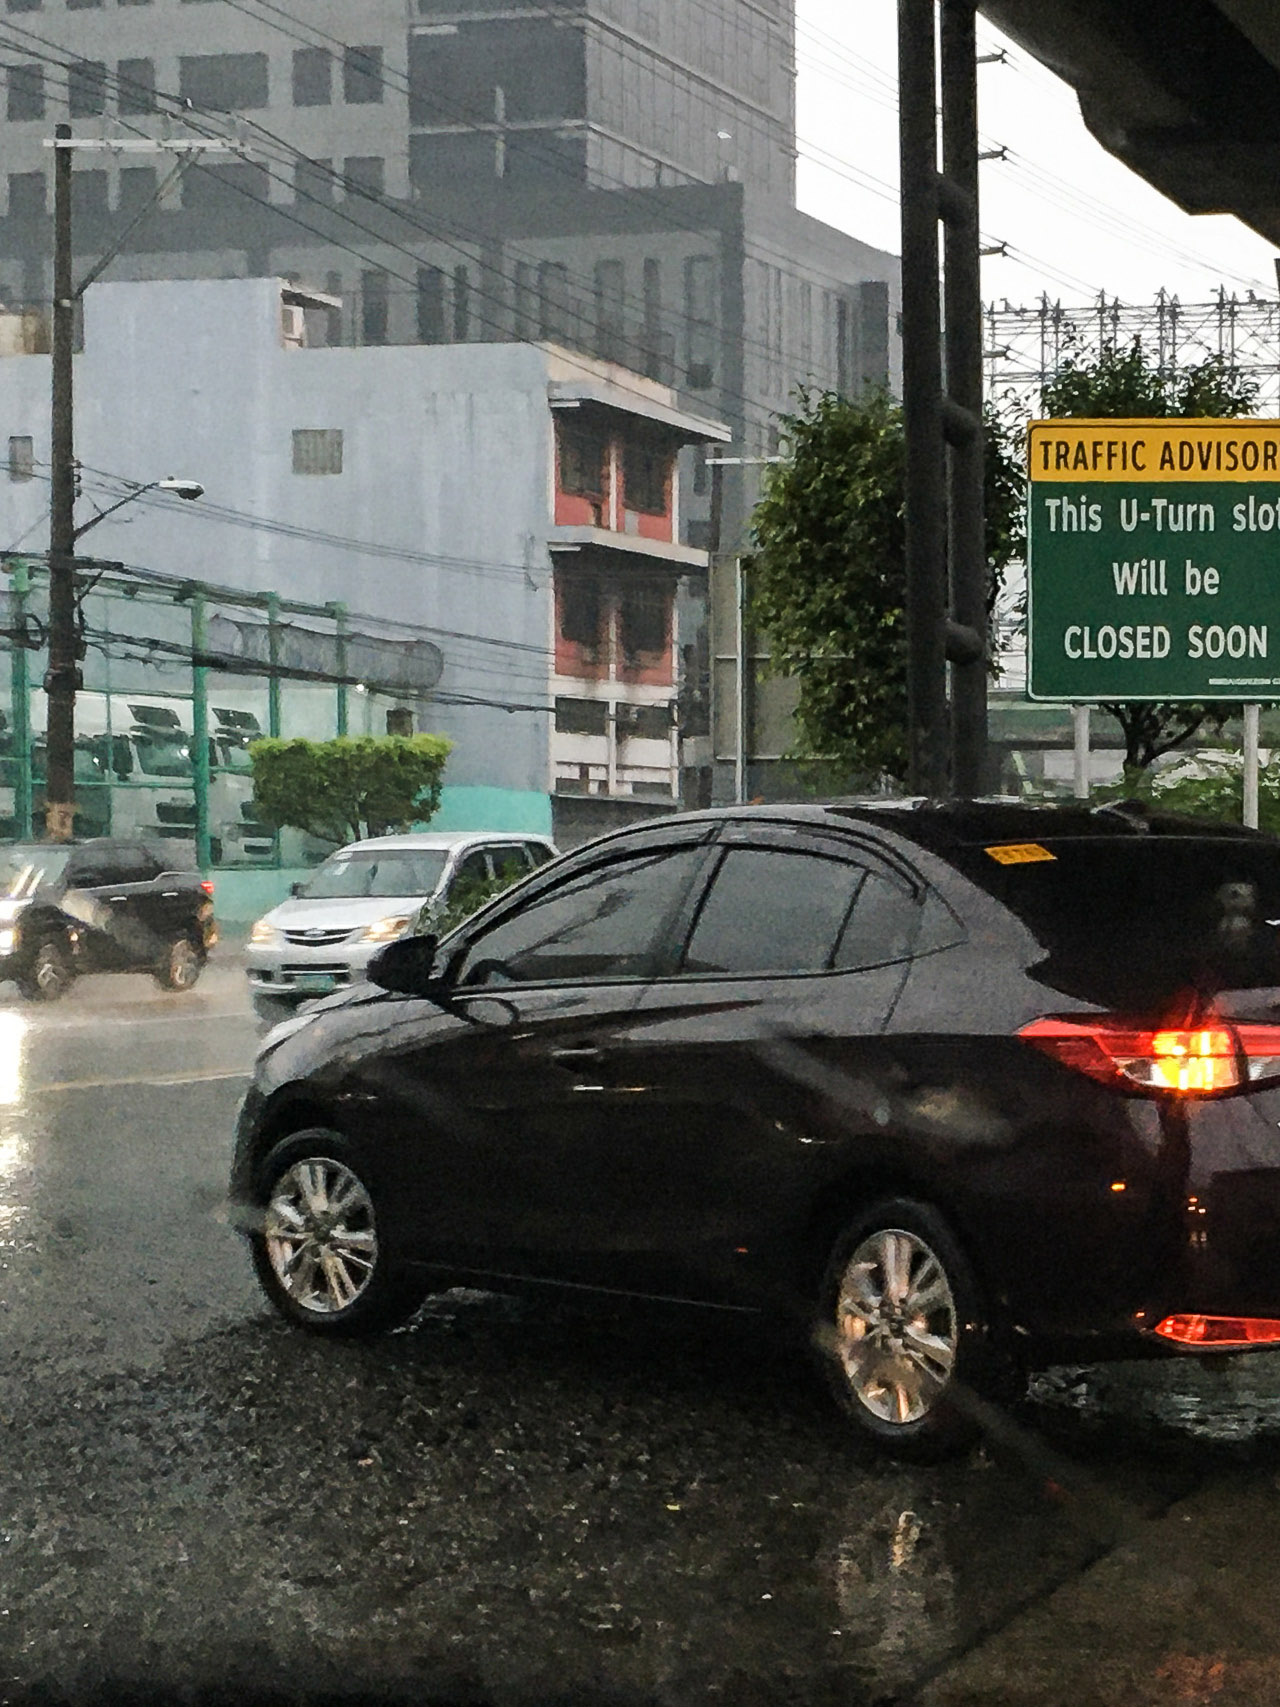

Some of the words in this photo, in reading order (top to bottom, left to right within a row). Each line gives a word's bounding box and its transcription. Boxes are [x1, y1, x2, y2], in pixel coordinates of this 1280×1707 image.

[1039, 440, 1147, 471] TRAFFIC
[1044, 495, 1102, 532] This
[1120, 498, 1215, 532] U-Turn
[1112, 558, 1168, 596] Will
[1184, 559, 1221, 596] be
[1064, 625, 1171, 659] CLOSED
[1187, 625, 1268, 659] SOON
